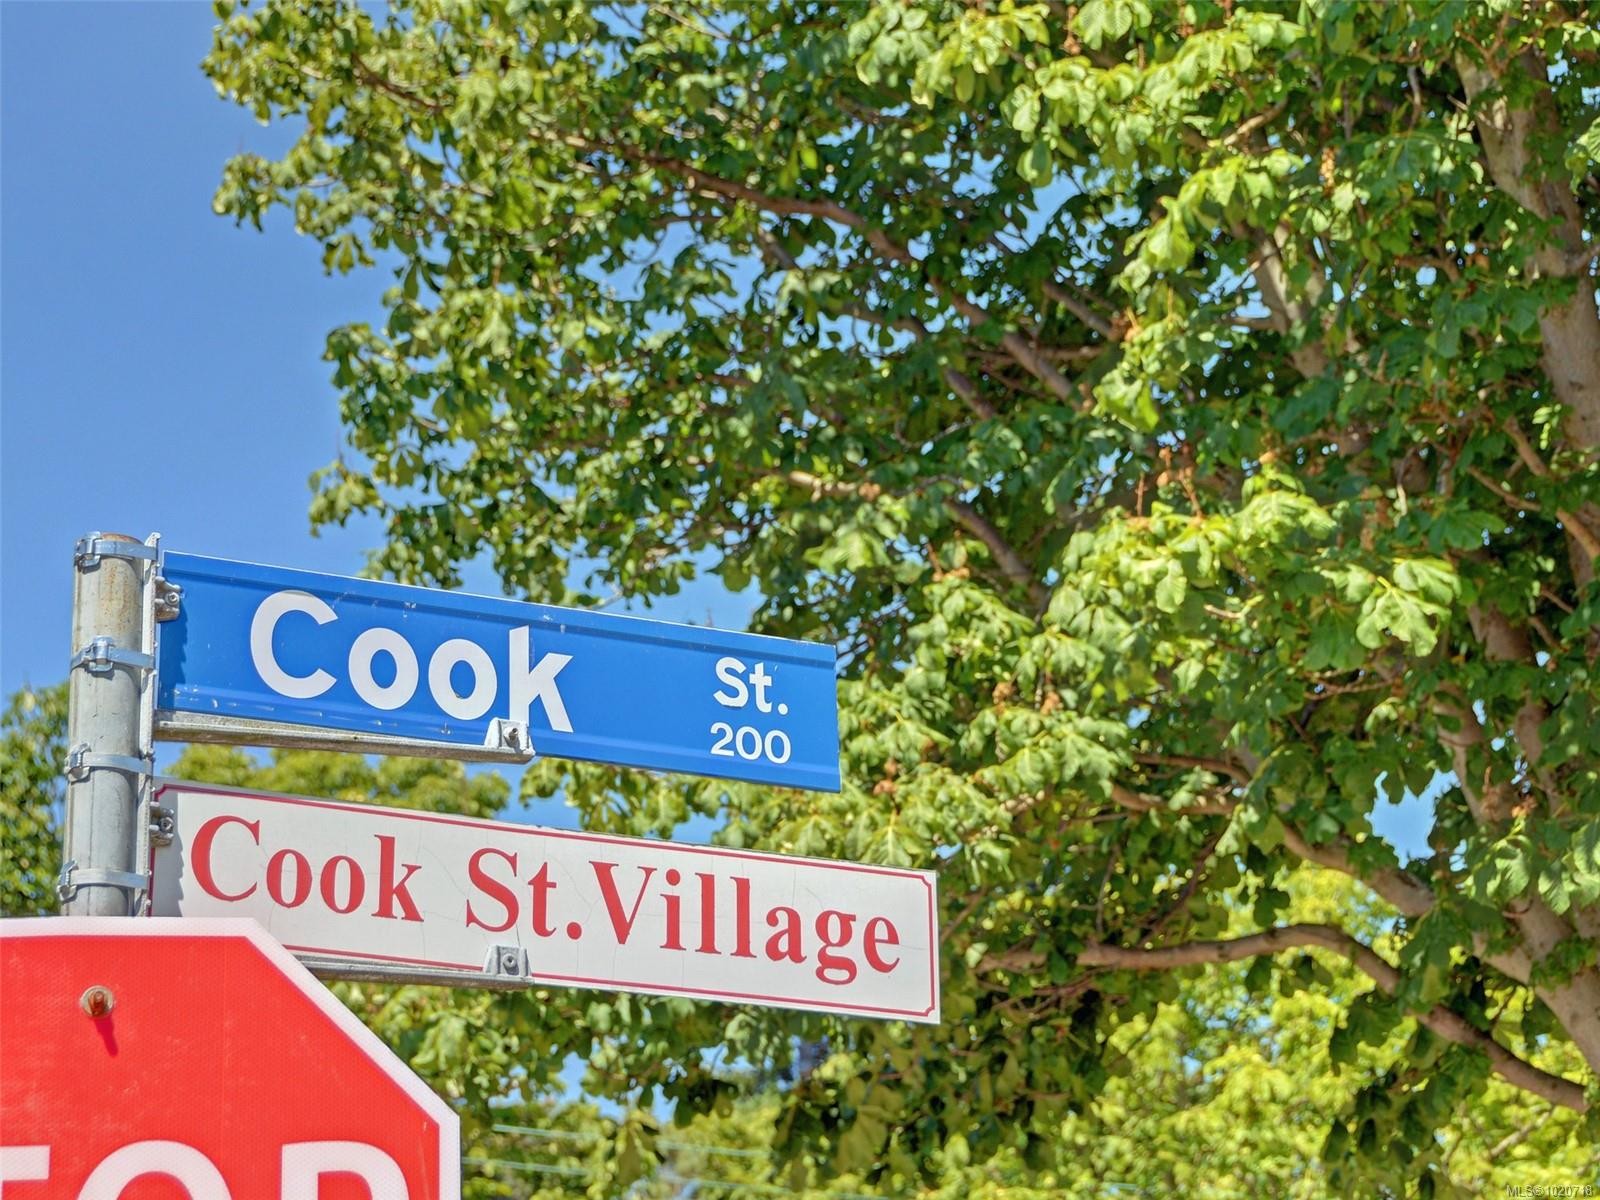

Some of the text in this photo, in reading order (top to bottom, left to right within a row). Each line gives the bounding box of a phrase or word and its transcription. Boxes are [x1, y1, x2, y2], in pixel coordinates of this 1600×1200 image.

[250, 590, 789, 733] Cook St.
[710, 722, 792, 764] 200
[191, 815, 424, 923] Cook
